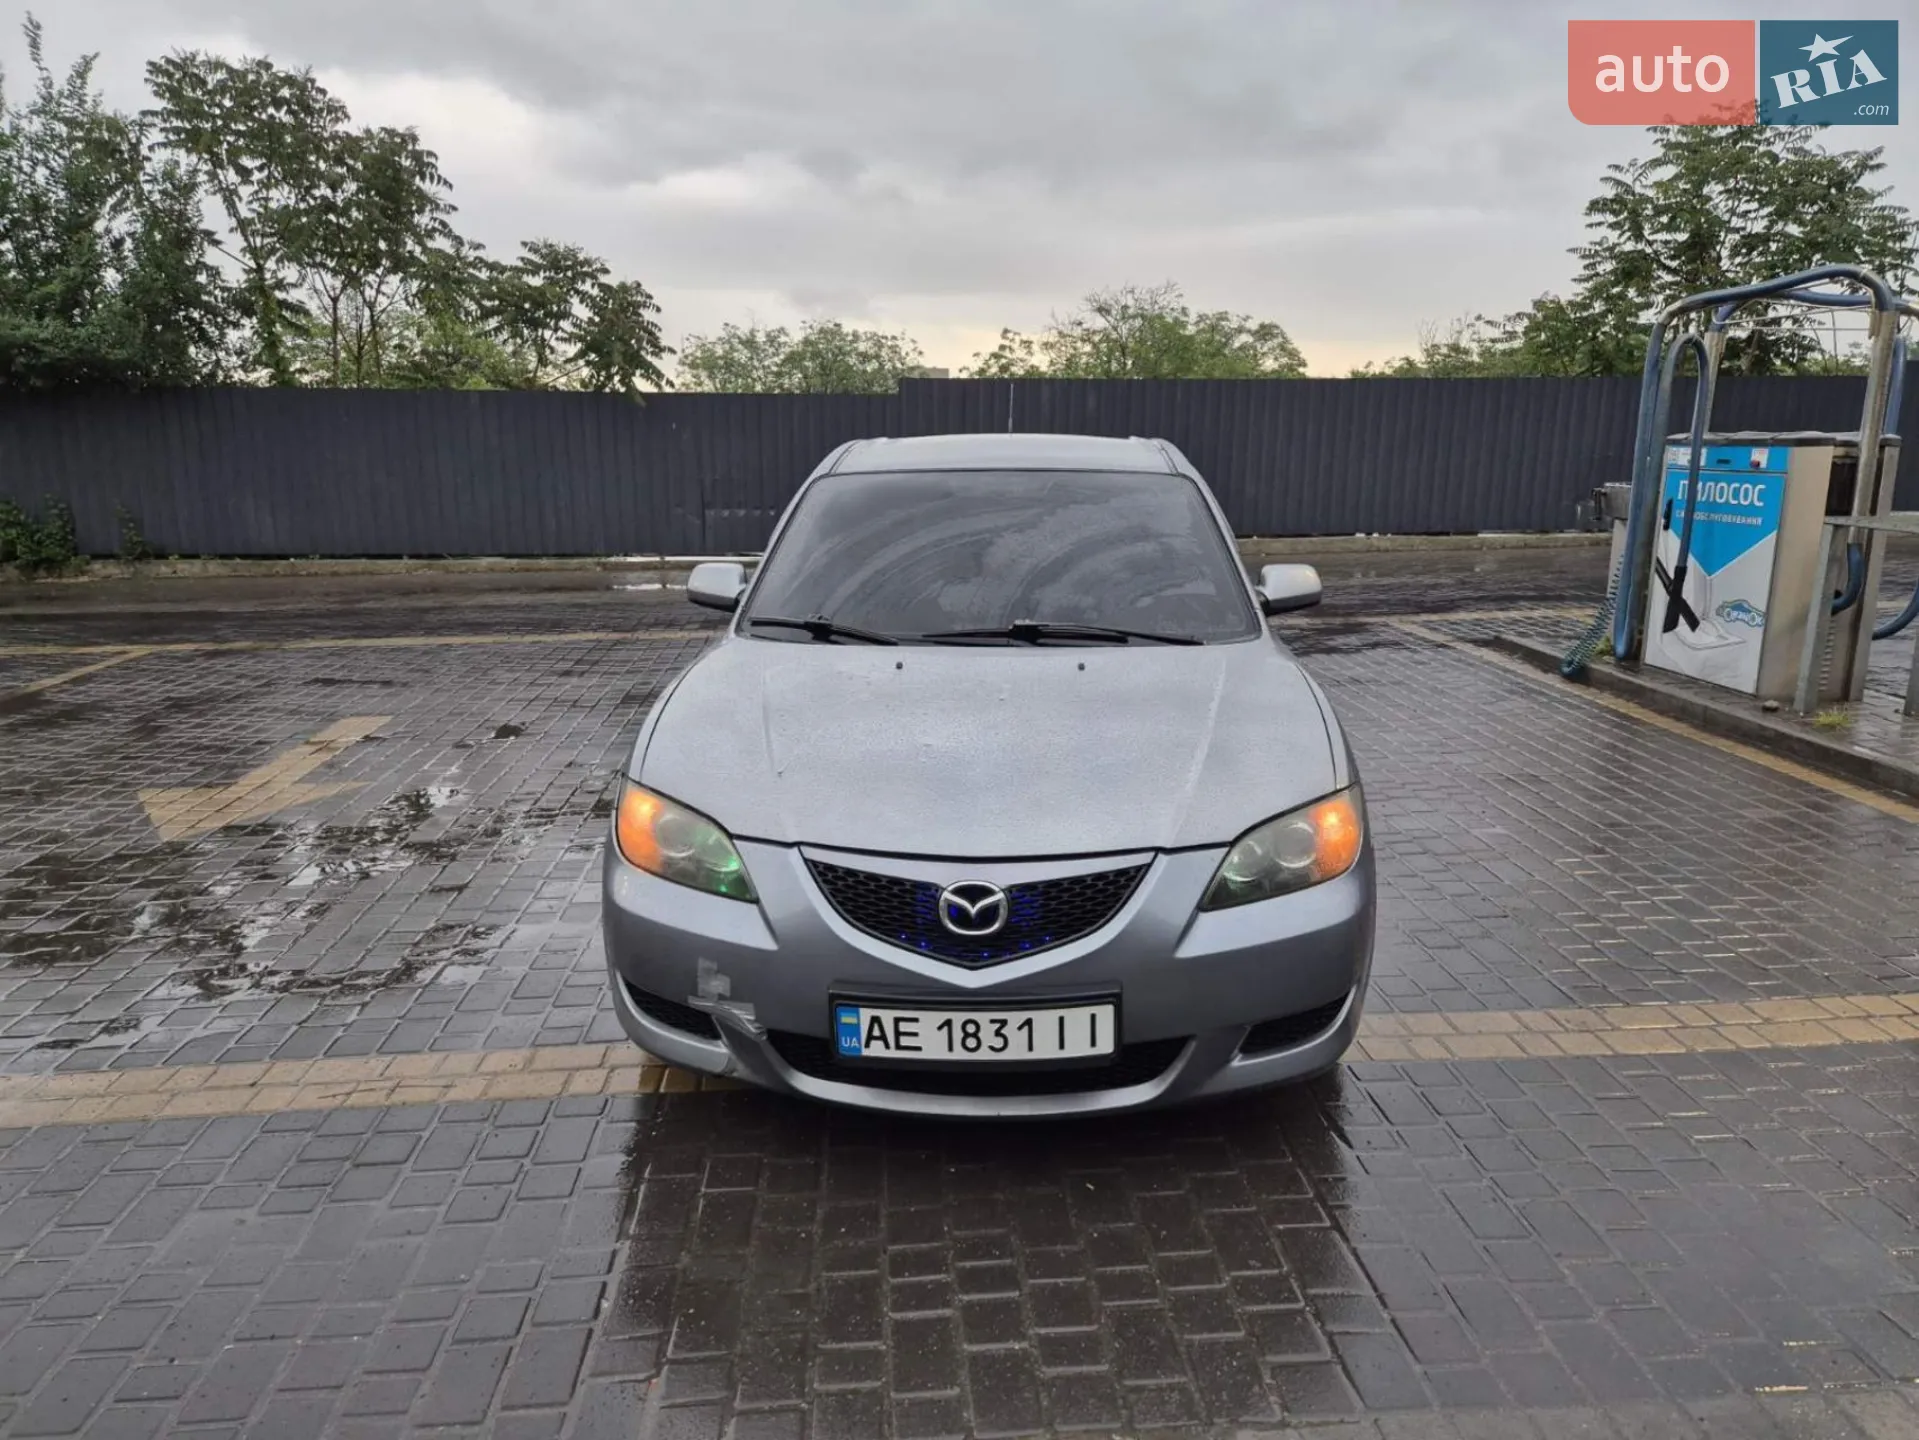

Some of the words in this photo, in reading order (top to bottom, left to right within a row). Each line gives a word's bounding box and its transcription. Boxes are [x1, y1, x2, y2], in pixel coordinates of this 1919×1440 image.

[842, 1037, 859, 1047] UA
[864, 1015, 923, 1051] AE
[937, 1017, 1034, 1052] 1831
